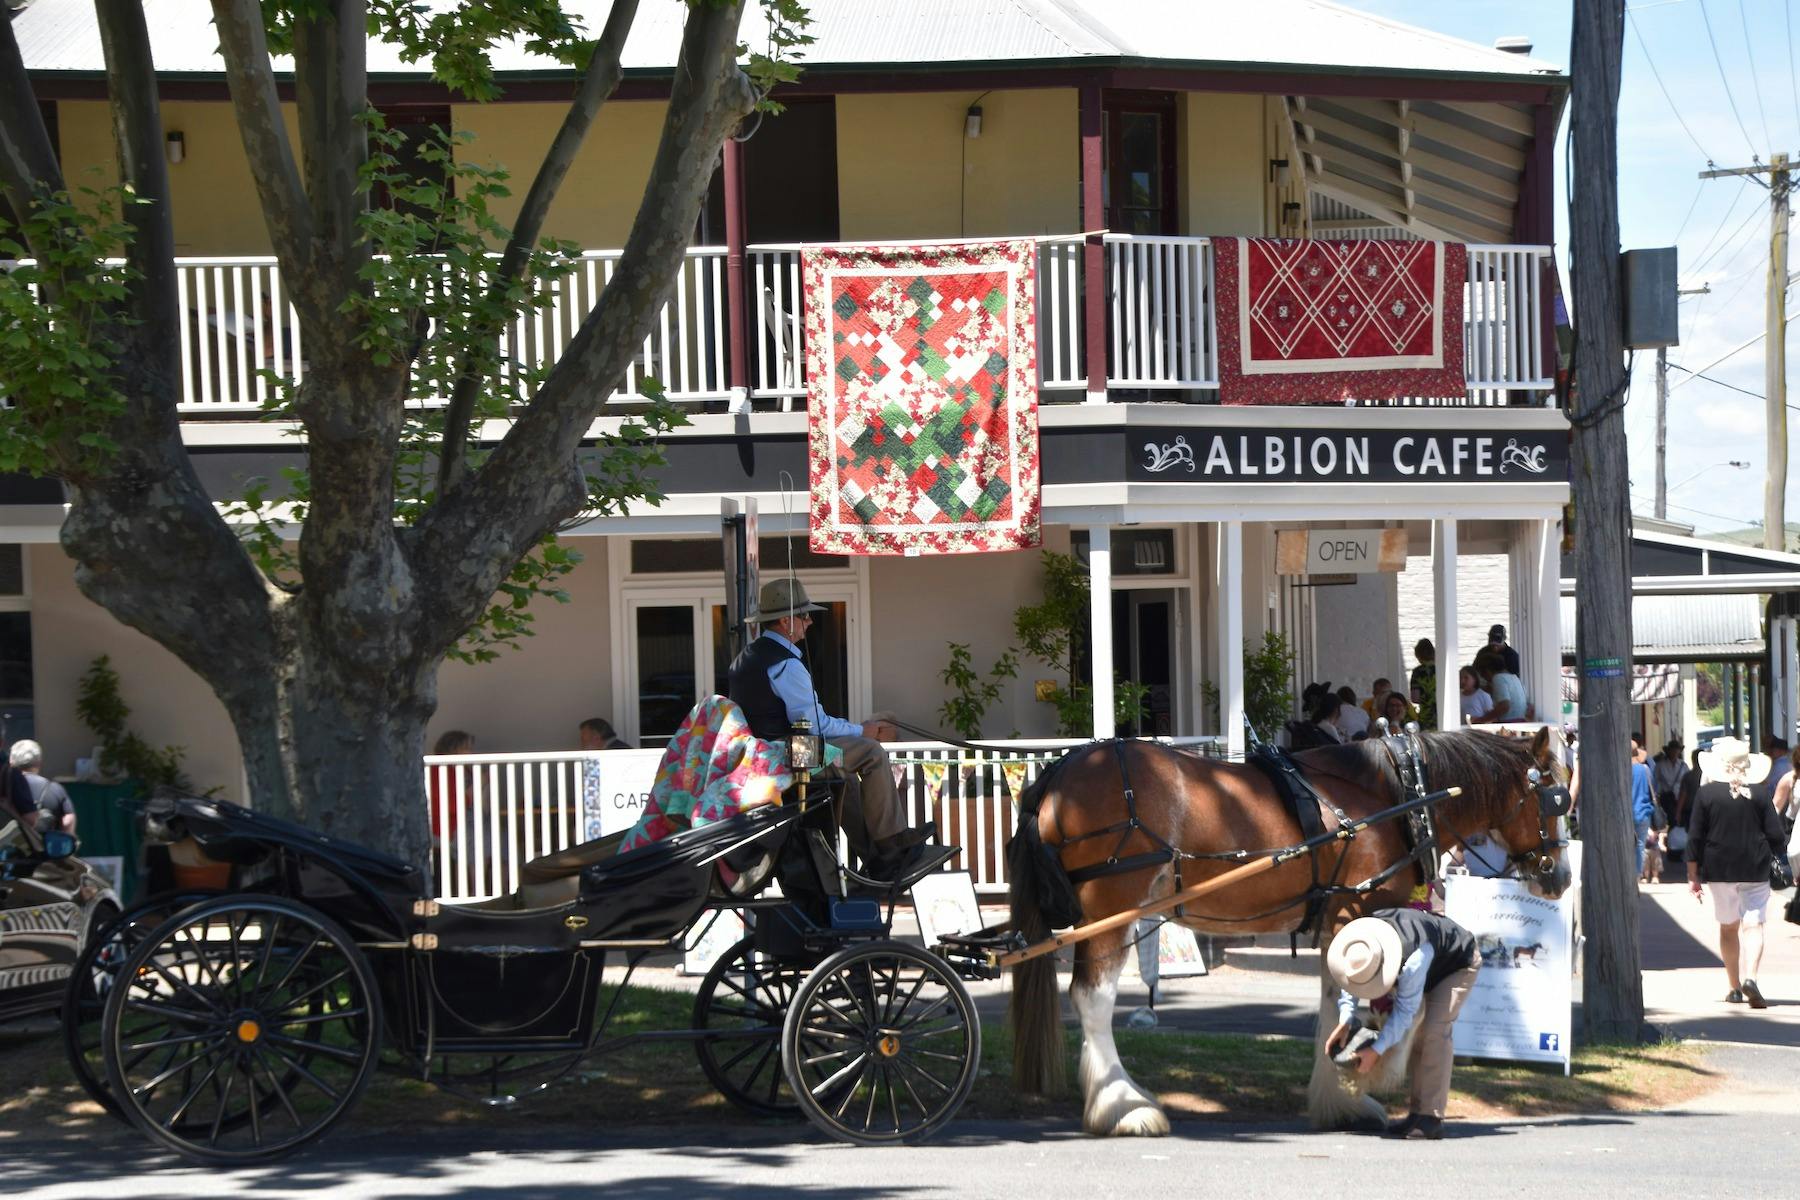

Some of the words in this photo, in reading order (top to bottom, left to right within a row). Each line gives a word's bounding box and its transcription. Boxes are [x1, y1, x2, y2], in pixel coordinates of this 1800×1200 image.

[1203, 435, 1370, 475] ALBION
[1392, 436, 1494, 475] CAFE
[1319, 541, 1367, 561] OPEN
